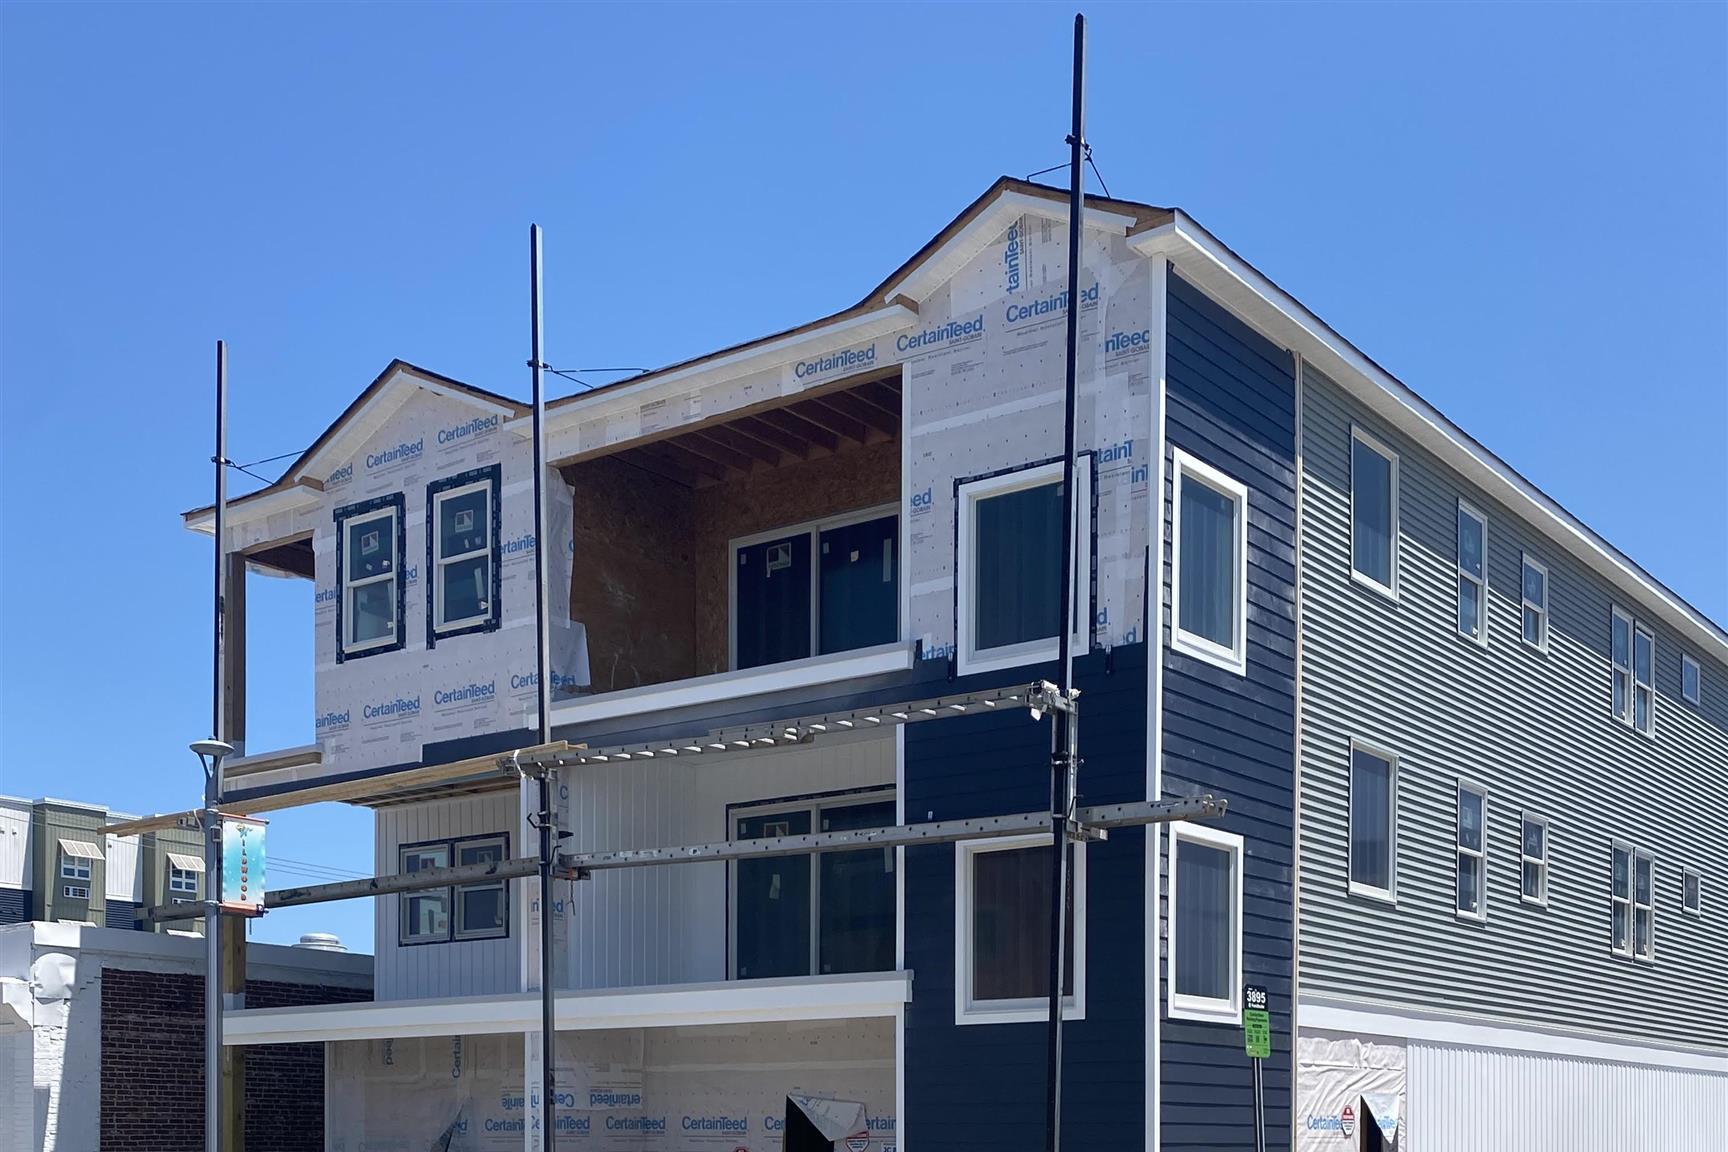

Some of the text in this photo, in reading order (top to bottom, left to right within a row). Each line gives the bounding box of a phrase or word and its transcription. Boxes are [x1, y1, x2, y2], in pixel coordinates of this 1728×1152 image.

[1006, 283, 1099, 322] CertainTed
[896, 314, 984, 352] CertainTeed
[795, 344, 875, 378] CertainTeed
[438, 414, 498, 444] CertainTeed
[366, 438, 423, 469] CertainTeed
[434, 680, 495, 705] CertainTeed
[363, 696, 420, 719] CertainTeed
[1246, 990, 1266, 1004] 3895
[606, 1116, 665, 1130] CertainTeed
[682, 1116, 747, 1130] CertainTeed
